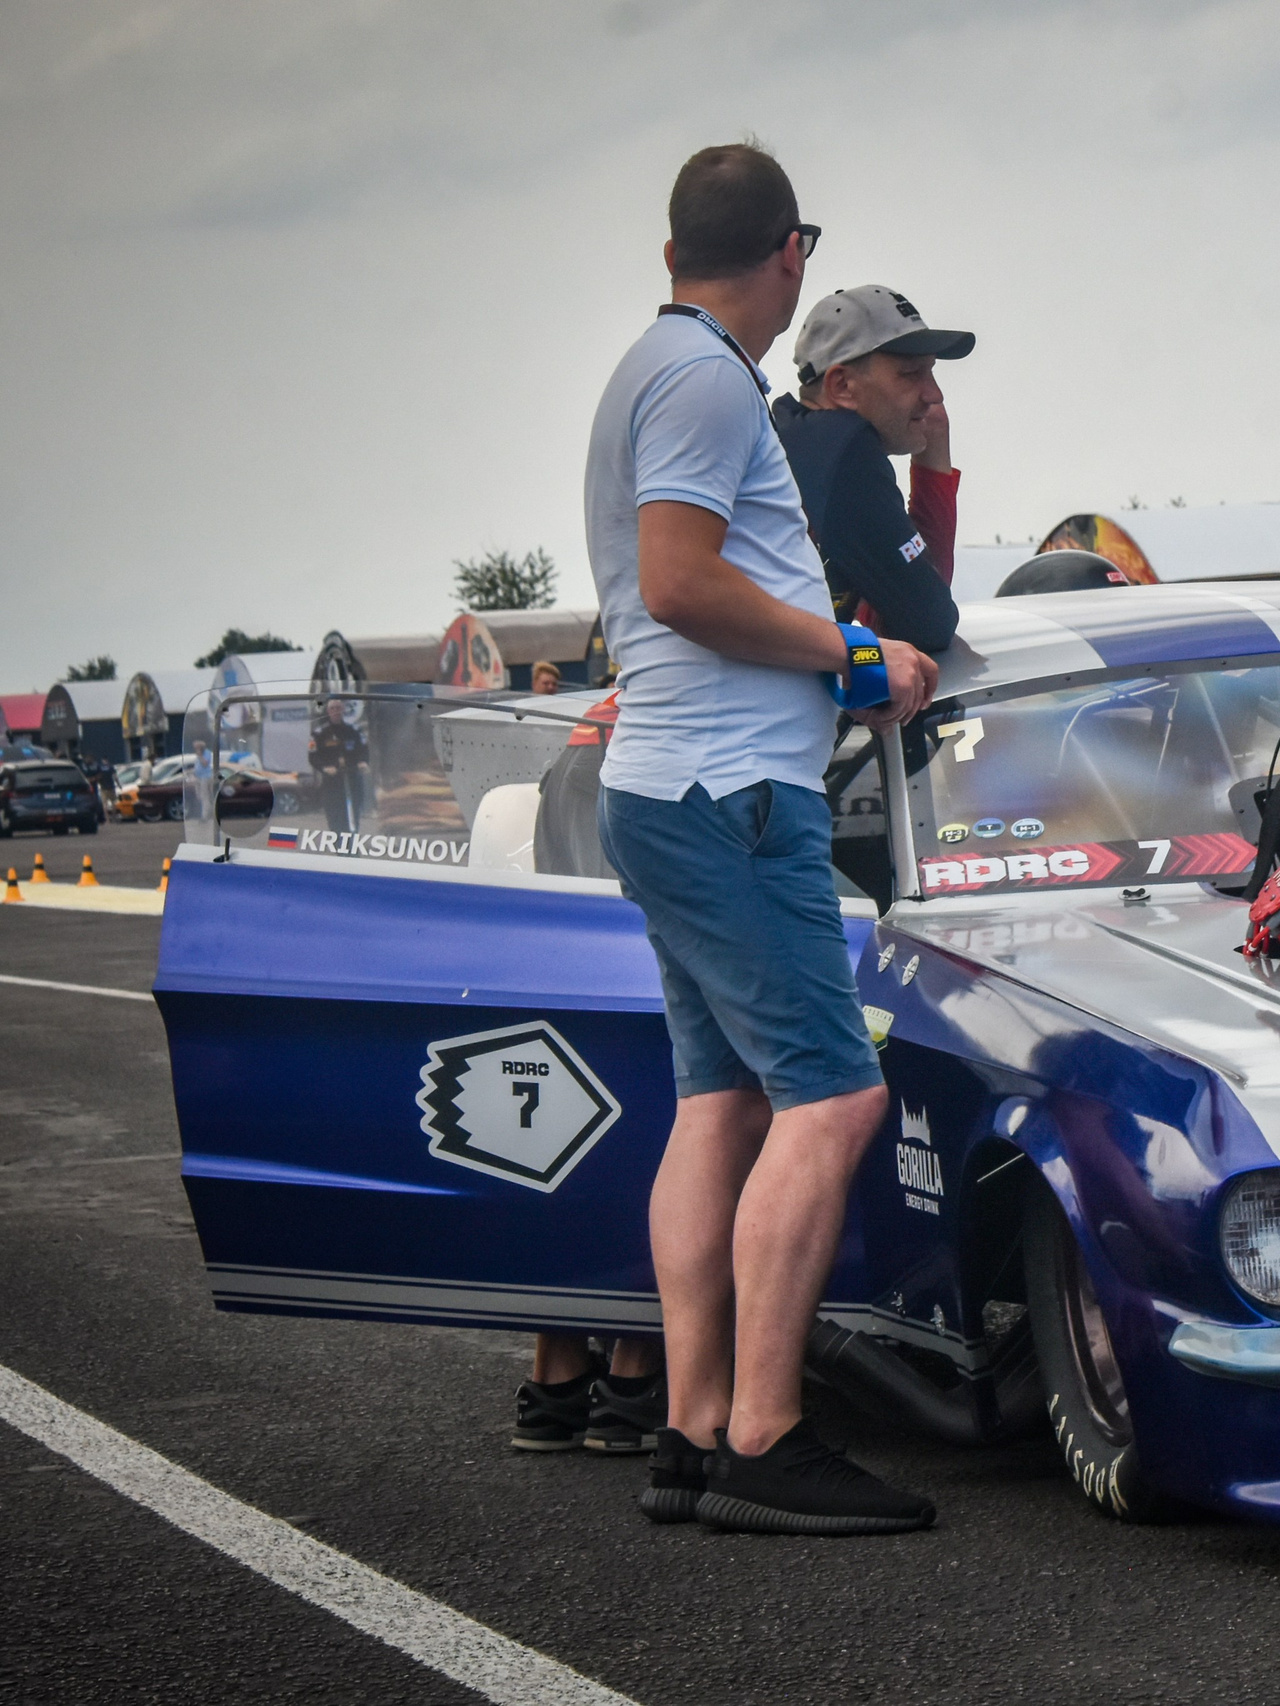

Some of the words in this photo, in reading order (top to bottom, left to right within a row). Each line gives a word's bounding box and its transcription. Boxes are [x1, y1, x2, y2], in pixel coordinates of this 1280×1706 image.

[696, 312, 727, 337] RDRC
[853, 650, 879, 661] OMP
[937, 717, 984, 763] 7
[300, 830, 469, 863] KRIKSUNOV
[922, 850, 1090, 888] RDRC
[1138, 839, 1171, 874] 7
[501, 1060, 550, 1077] RDRC
[512, 1081, 540, 1129] 7
[896, 1143, 944, 1196] GORILLA
